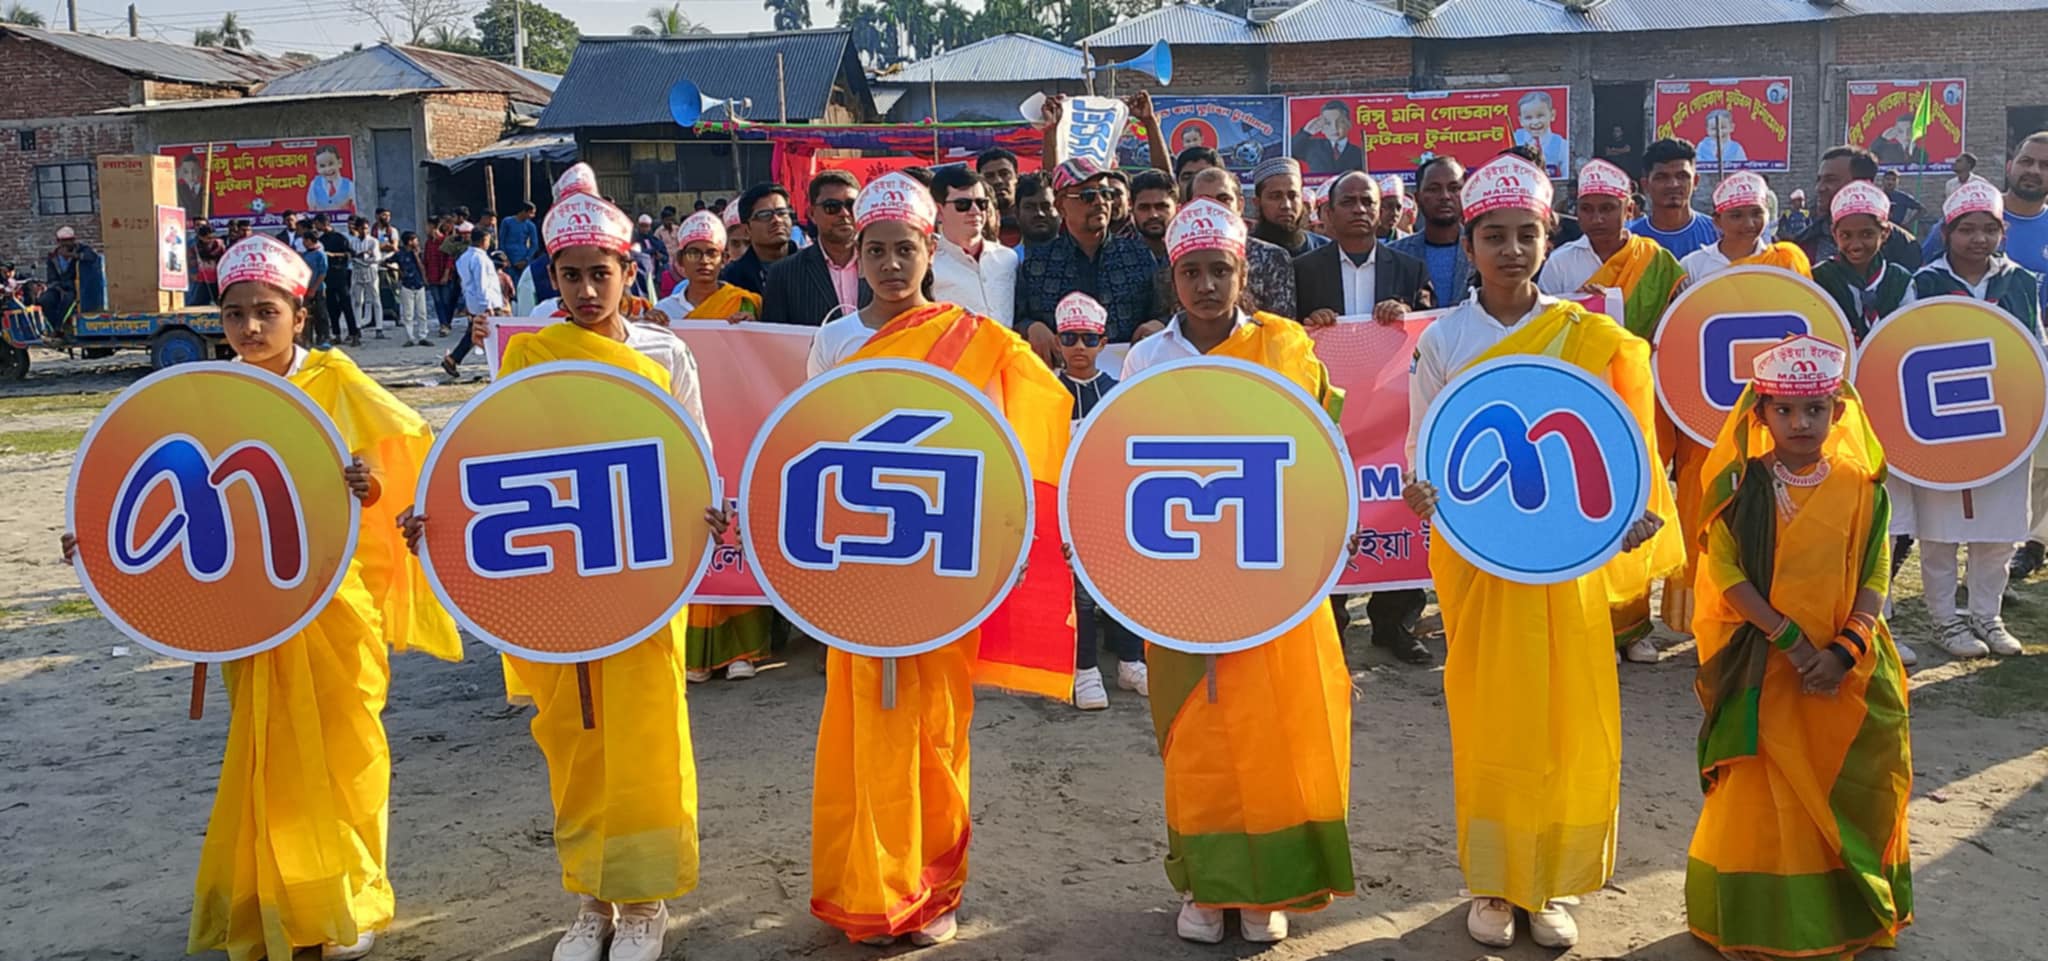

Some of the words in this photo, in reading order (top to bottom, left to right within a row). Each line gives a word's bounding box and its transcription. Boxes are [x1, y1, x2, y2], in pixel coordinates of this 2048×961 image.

[557, 225, 605, 234] MARCEL
[1777, 372, 1829, 381] MARCEL
[1900, 338, 2007, 446] E
[458, 437, 674, 578] মা
[1124, 435, 1296, 570] ল
[1350, 528, 1413, 571] ইয়া
